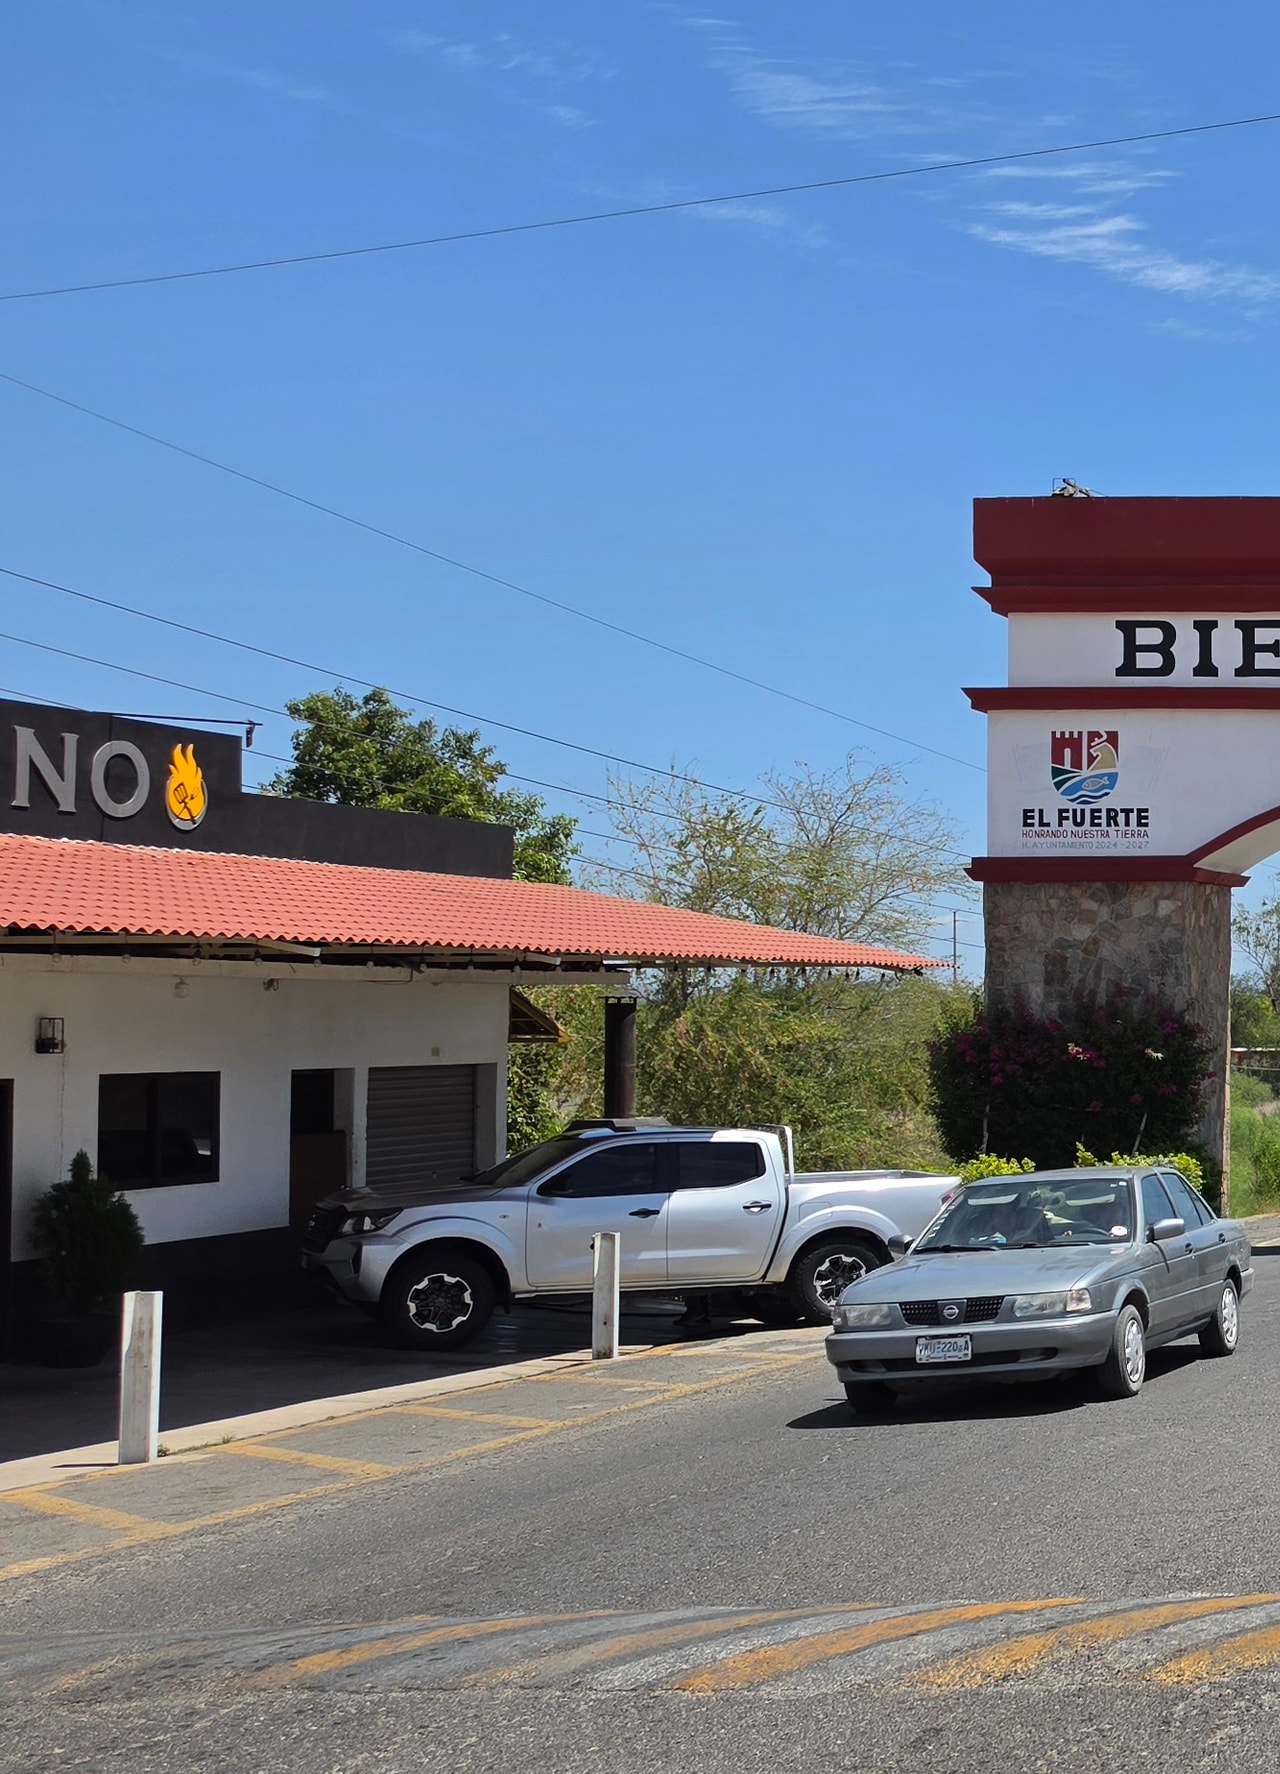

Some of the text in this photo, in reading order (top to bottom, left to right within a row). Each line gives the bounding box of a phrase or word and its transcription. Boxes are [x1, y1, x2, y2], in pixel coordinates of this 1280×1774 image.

[10, 725, 151, 818] NO
[1022, 807, 1149, 828] EL FUERTE
[1022, 829, 1149, 839] HONRANDO NUESTRA TIERRA
[1032, 841, 1094, 850] AYUNTAMIENTO
